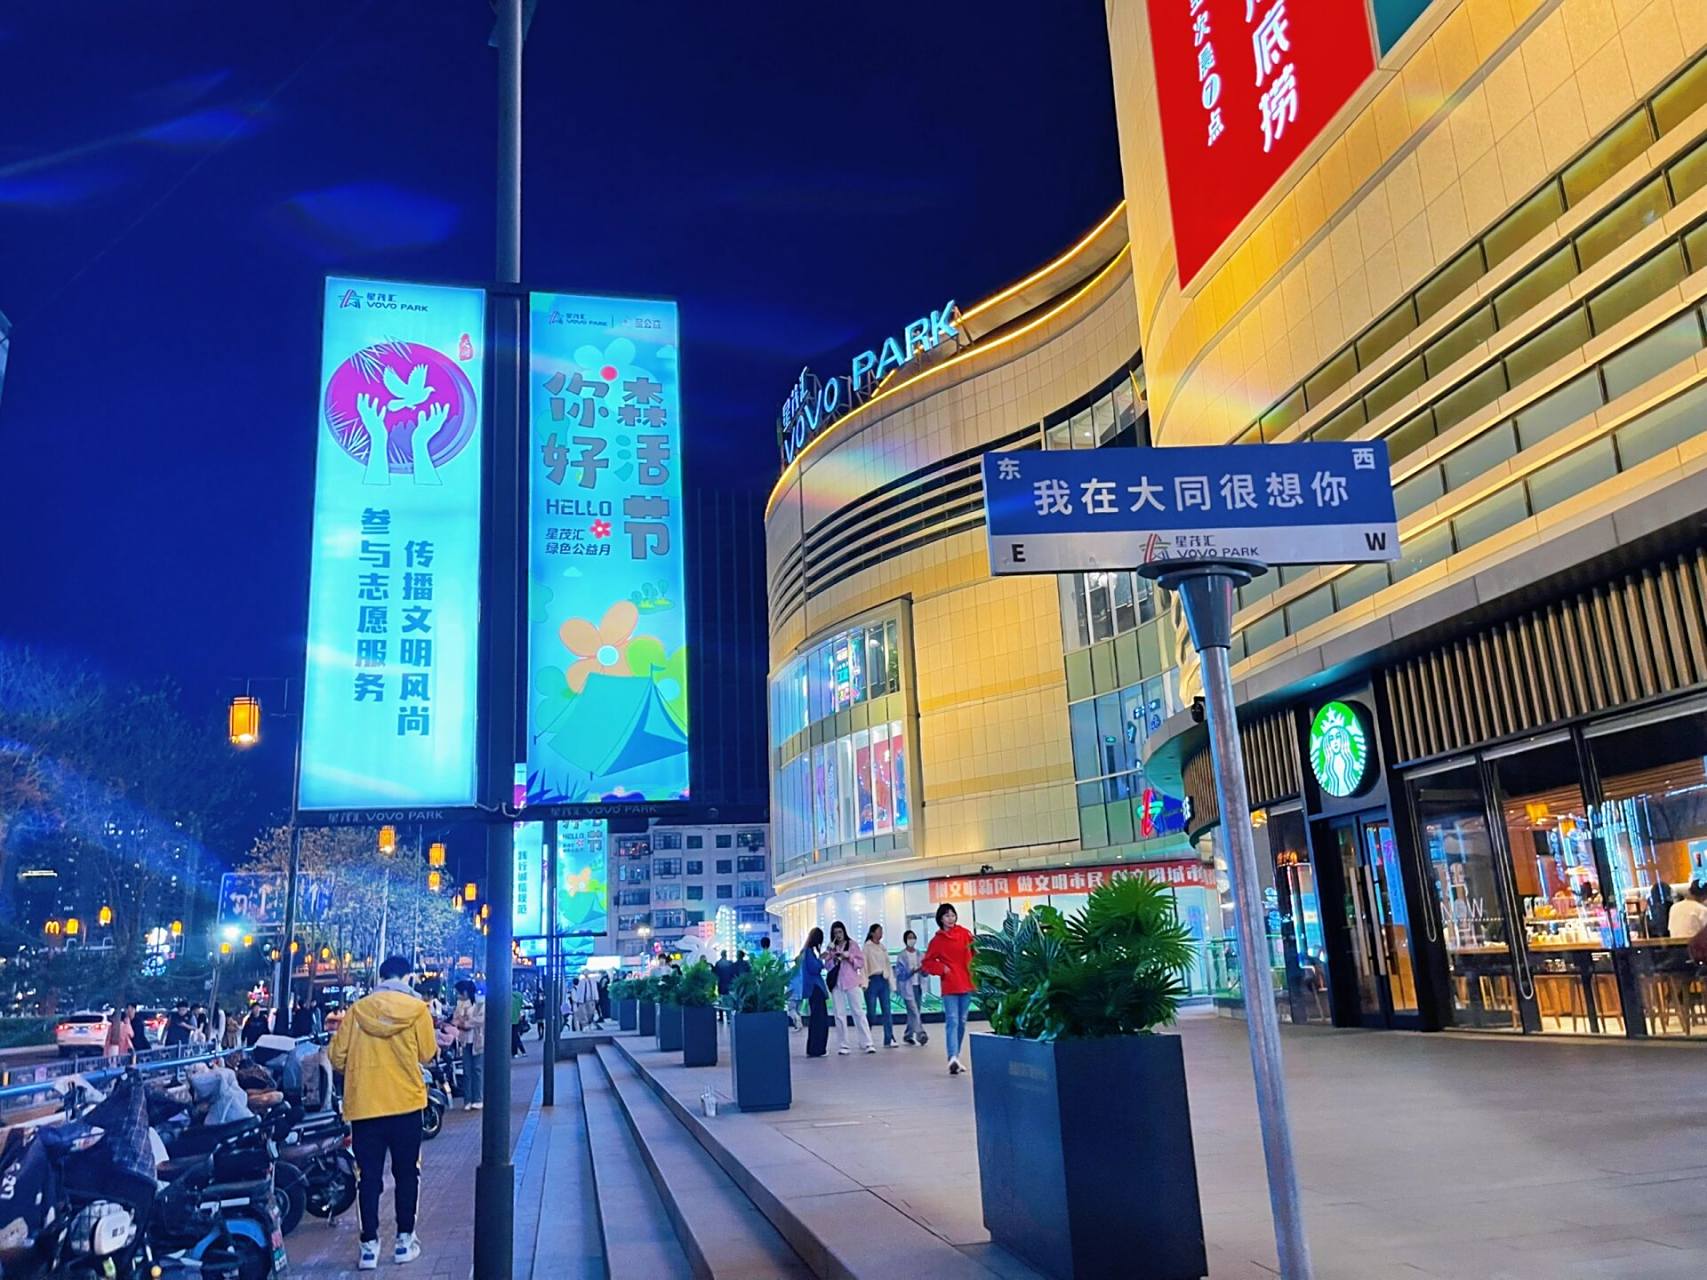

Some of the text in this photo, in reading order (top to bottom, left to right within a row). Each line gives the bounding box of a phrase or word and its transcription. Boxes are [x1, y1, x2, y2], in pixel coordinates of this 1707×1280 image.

[367, 301, 428, 312] VOVO PARK
[784, 299, 959, 464] VOVO PARK
[542, 371, 610, 490] 你好
[1351, 447, 1376, 470] 西
[614, 376, 671, 561] 森活节
[997, 457, 1021, 481] 东
[1033, 470, 1349, 518] 我在大同很想你
[546, 498, 612, 517] HELLO
[545, 527, 585, 541] 星茂汇
[1365, 532, 1387, 551] W
[544, 543, 611, 556] 绿色公益月
[1011, 544, 1026, 563] E
[1177, 546, 1259, 559] VOVO PARK
[397, 540, 434, 737] 传播文明风尚
[365, 809, 443, 822] VOVO PARK
